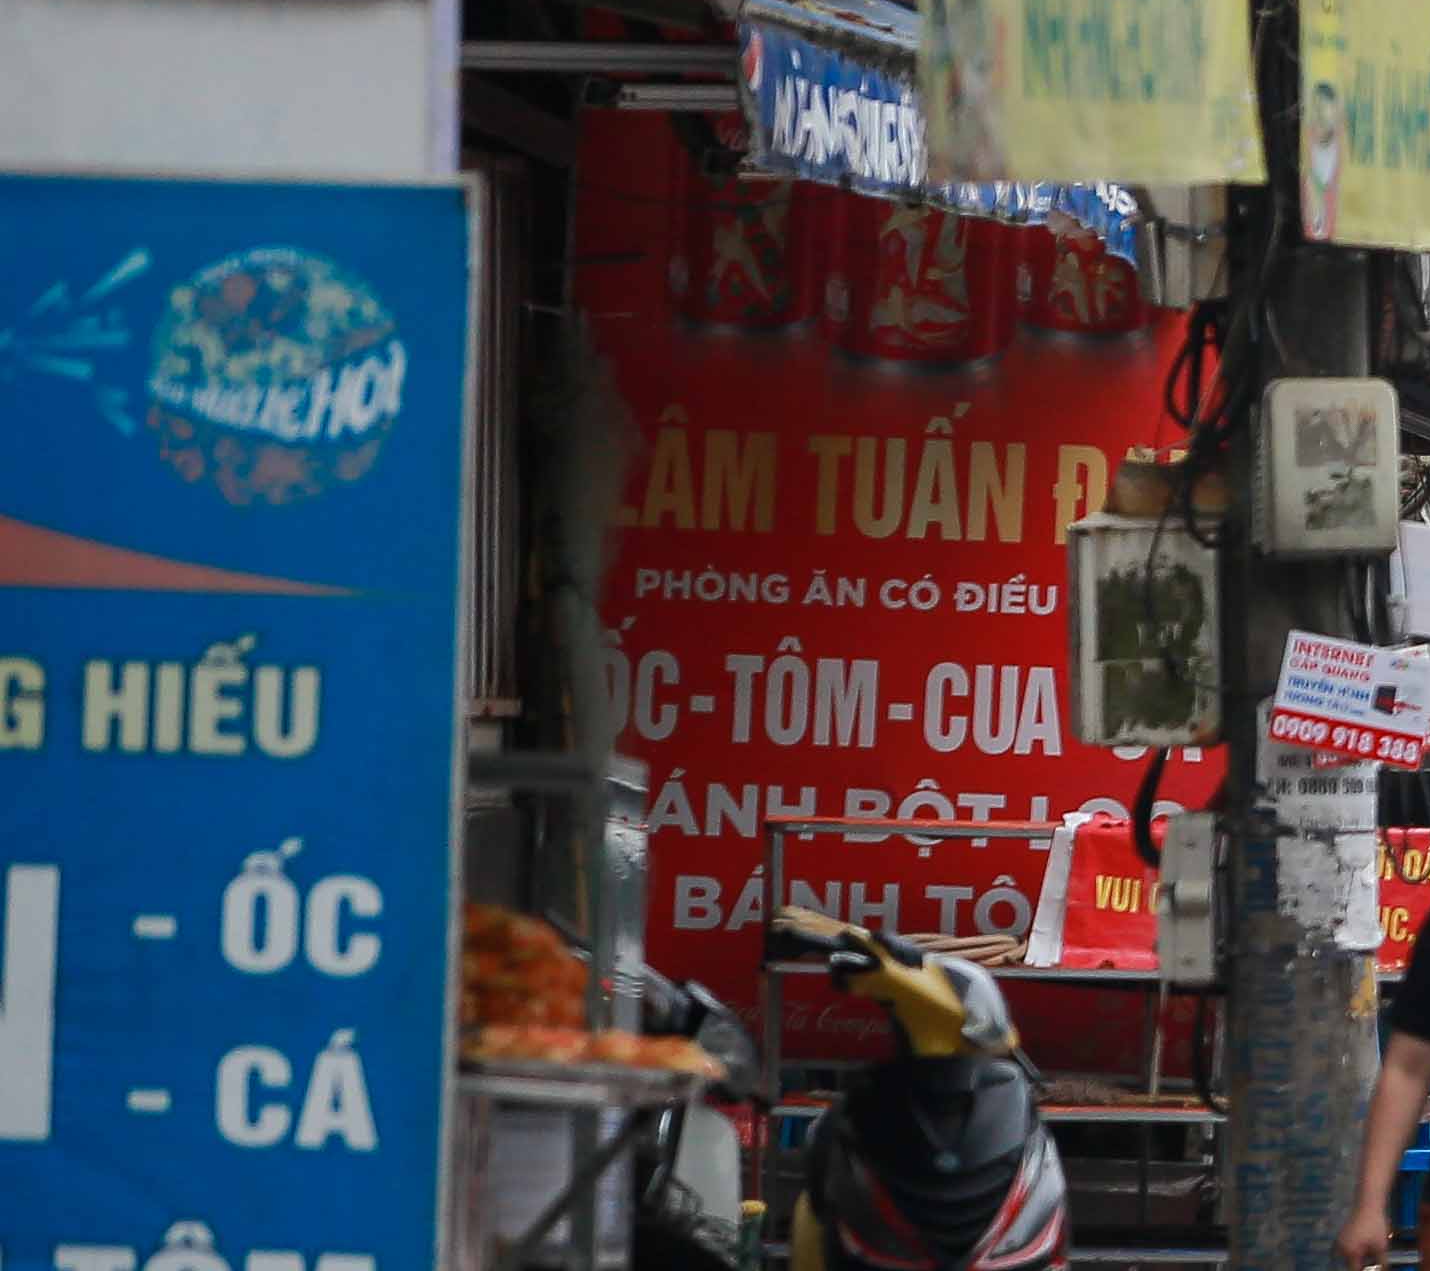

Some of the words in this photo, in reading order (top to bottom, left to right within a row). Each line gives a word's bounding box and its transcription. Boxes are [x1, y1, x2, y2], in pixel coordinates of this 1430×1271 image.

[808, 403, 1026, 543] TUẤN
[634, 563, 790, 604] PHÒNG
[802, 564, 865, 609] ĂN
[879, 572, 941, 612] CÓ
[83, 634, 321, 758] HIẾU
[221, 838, 383, 976] ỐC
[1095, 874, 1143, 914] VUI
[215, 1029, 379, 1152] CÁ
